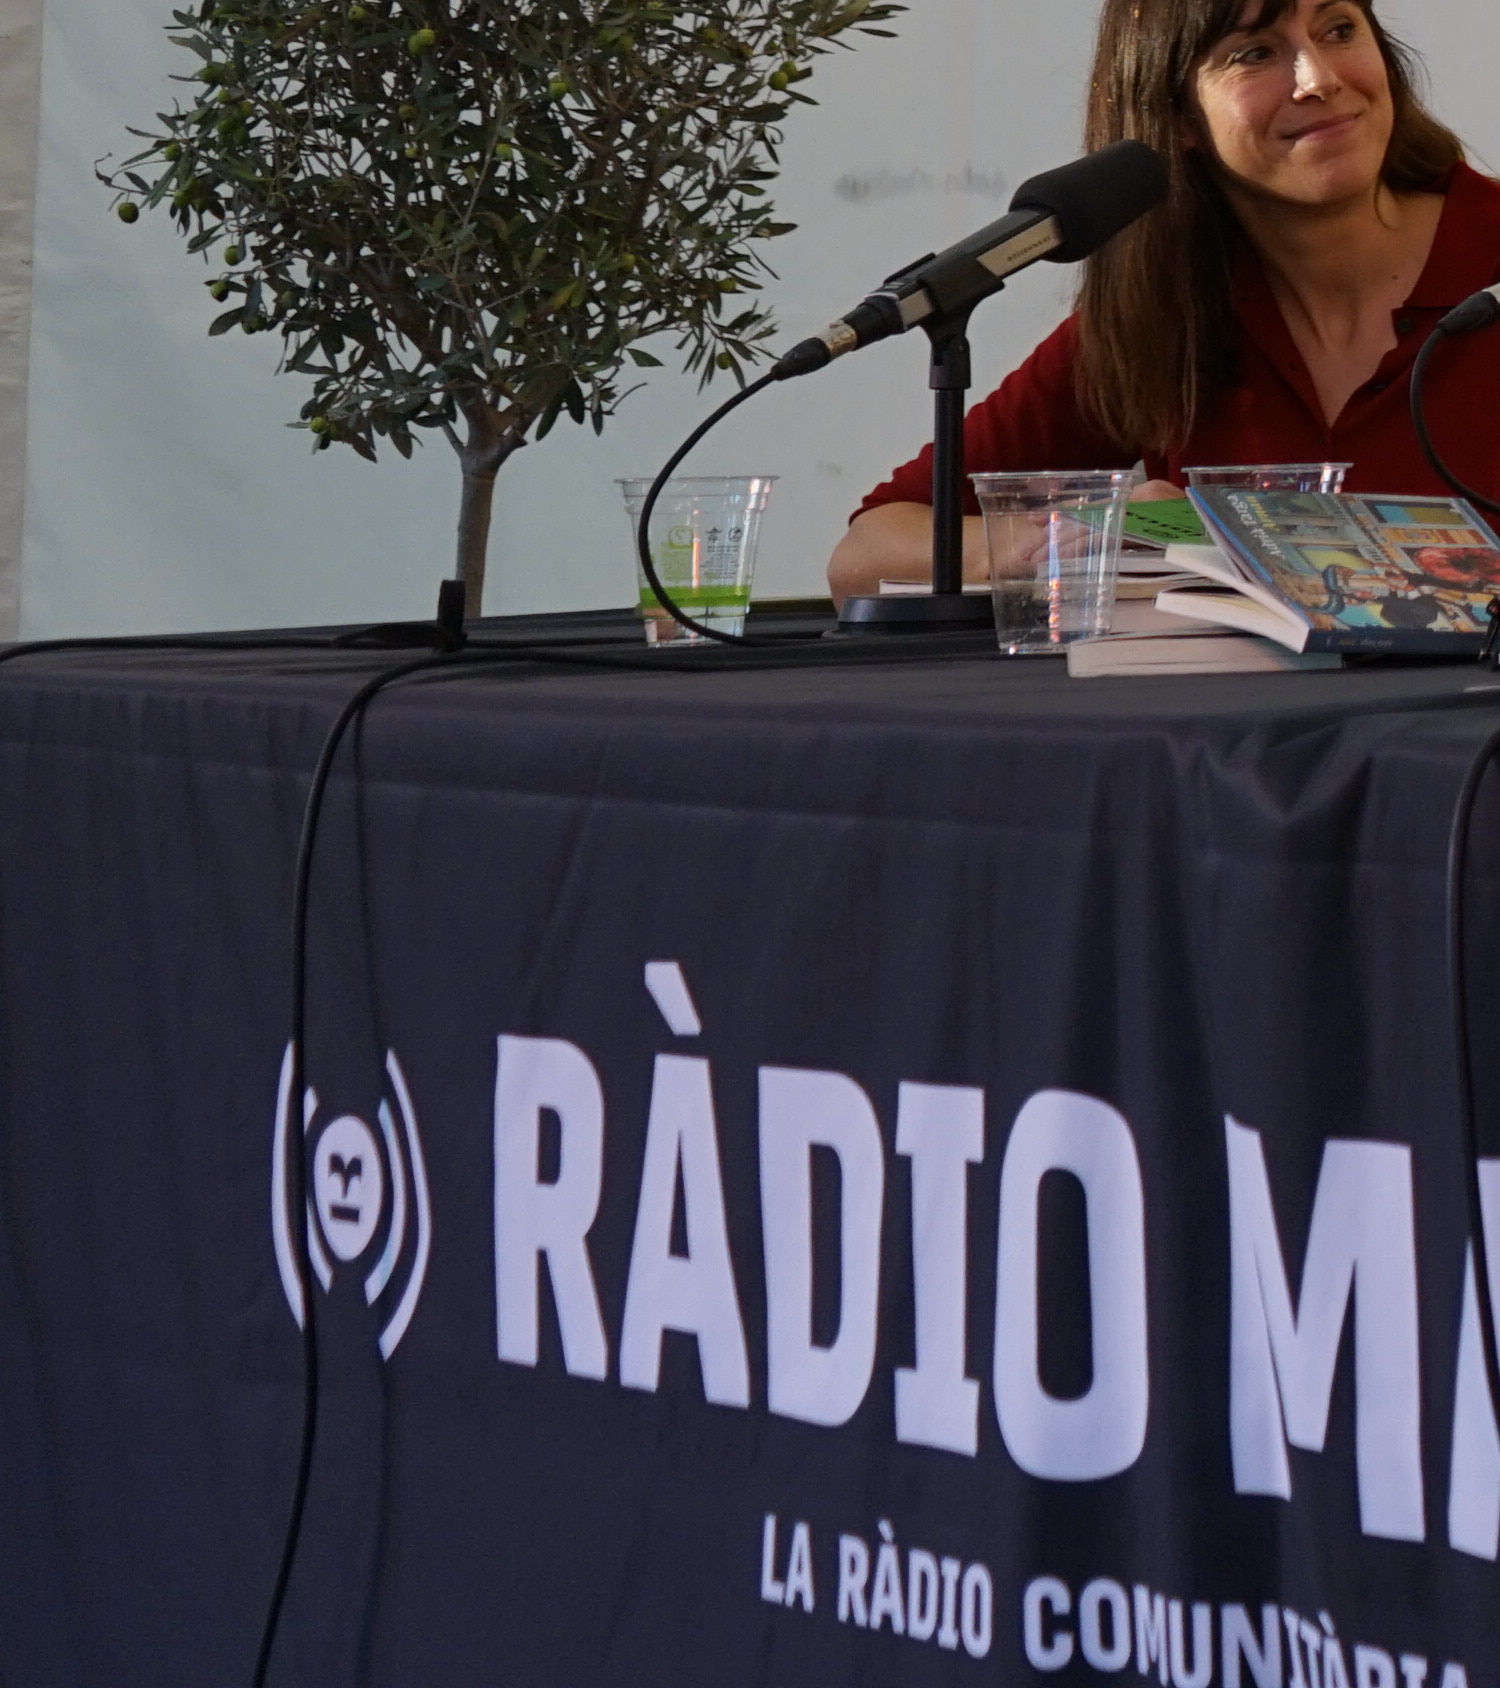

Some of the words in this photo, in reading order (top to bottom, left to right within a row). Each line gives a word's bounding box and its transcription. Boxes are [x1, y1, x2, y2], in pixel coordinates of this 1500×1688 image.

[494, 962, 1149, 1481] RÀDIO
[762, 1515, 814, 1612] LA
[838, 1520, 993, 1658] RÀDIO
[1024, 1578, 1468, 1688] COMUNITÀ
